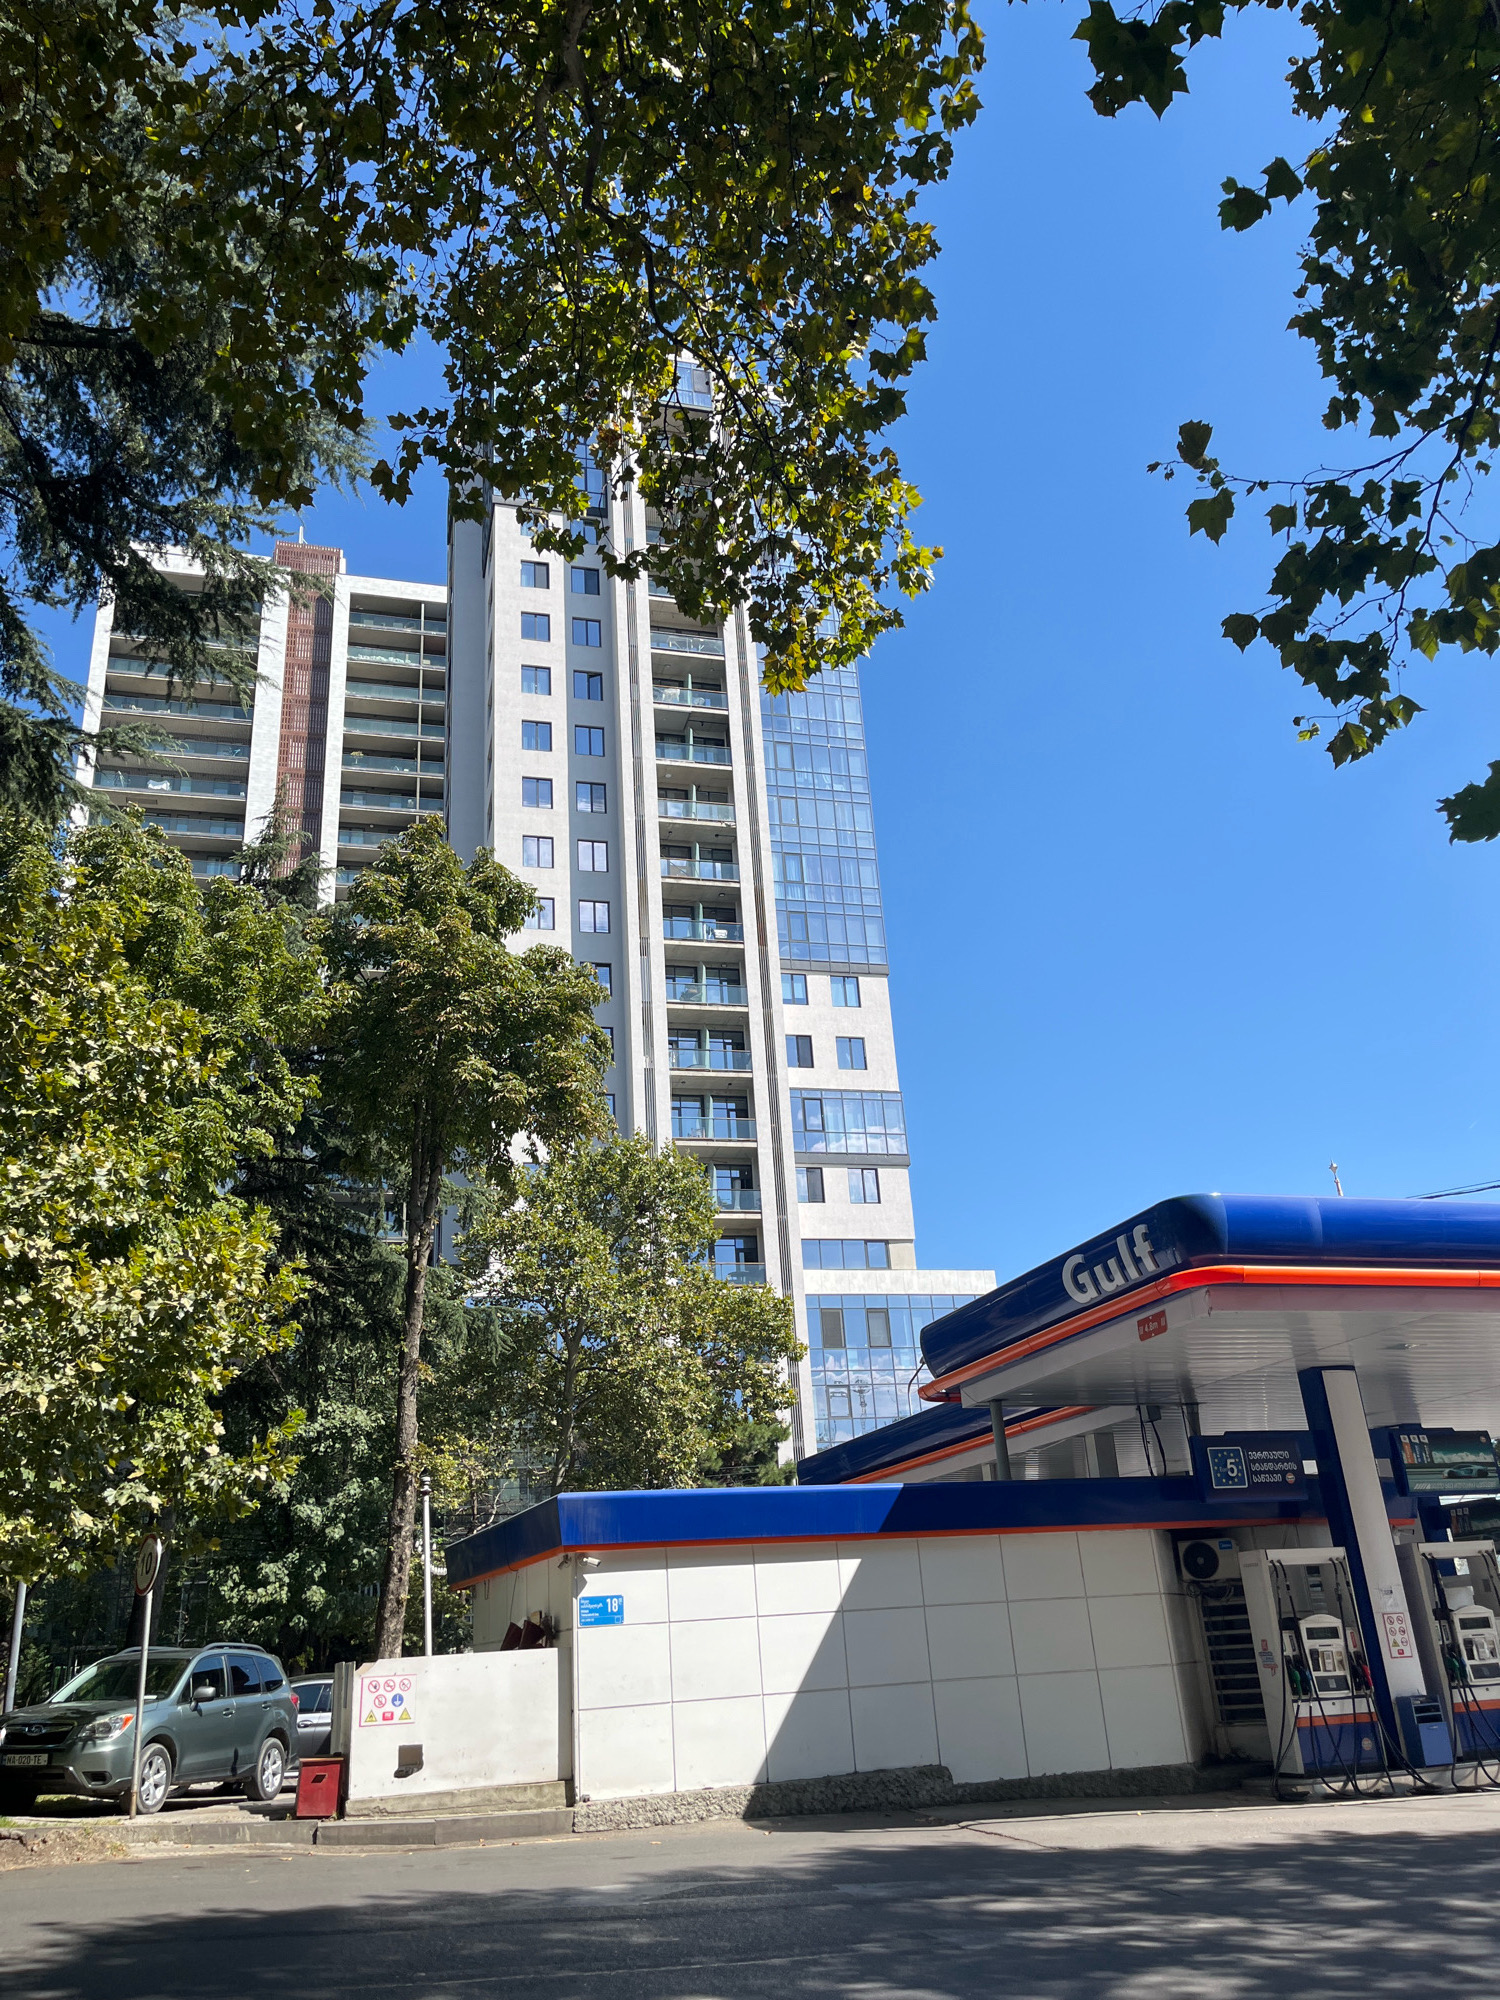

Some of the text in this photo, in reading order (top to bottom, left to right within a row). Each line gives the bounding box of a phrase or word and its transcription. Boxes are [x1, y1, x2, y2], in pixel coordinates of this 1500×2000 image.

[1062, 1224, 1159, 1304] Gulf
[1227, 1459, 1237, 1477] 5
[140, 1552, 153, 1576] 10
[606, 1598, 619, 1613] 18
